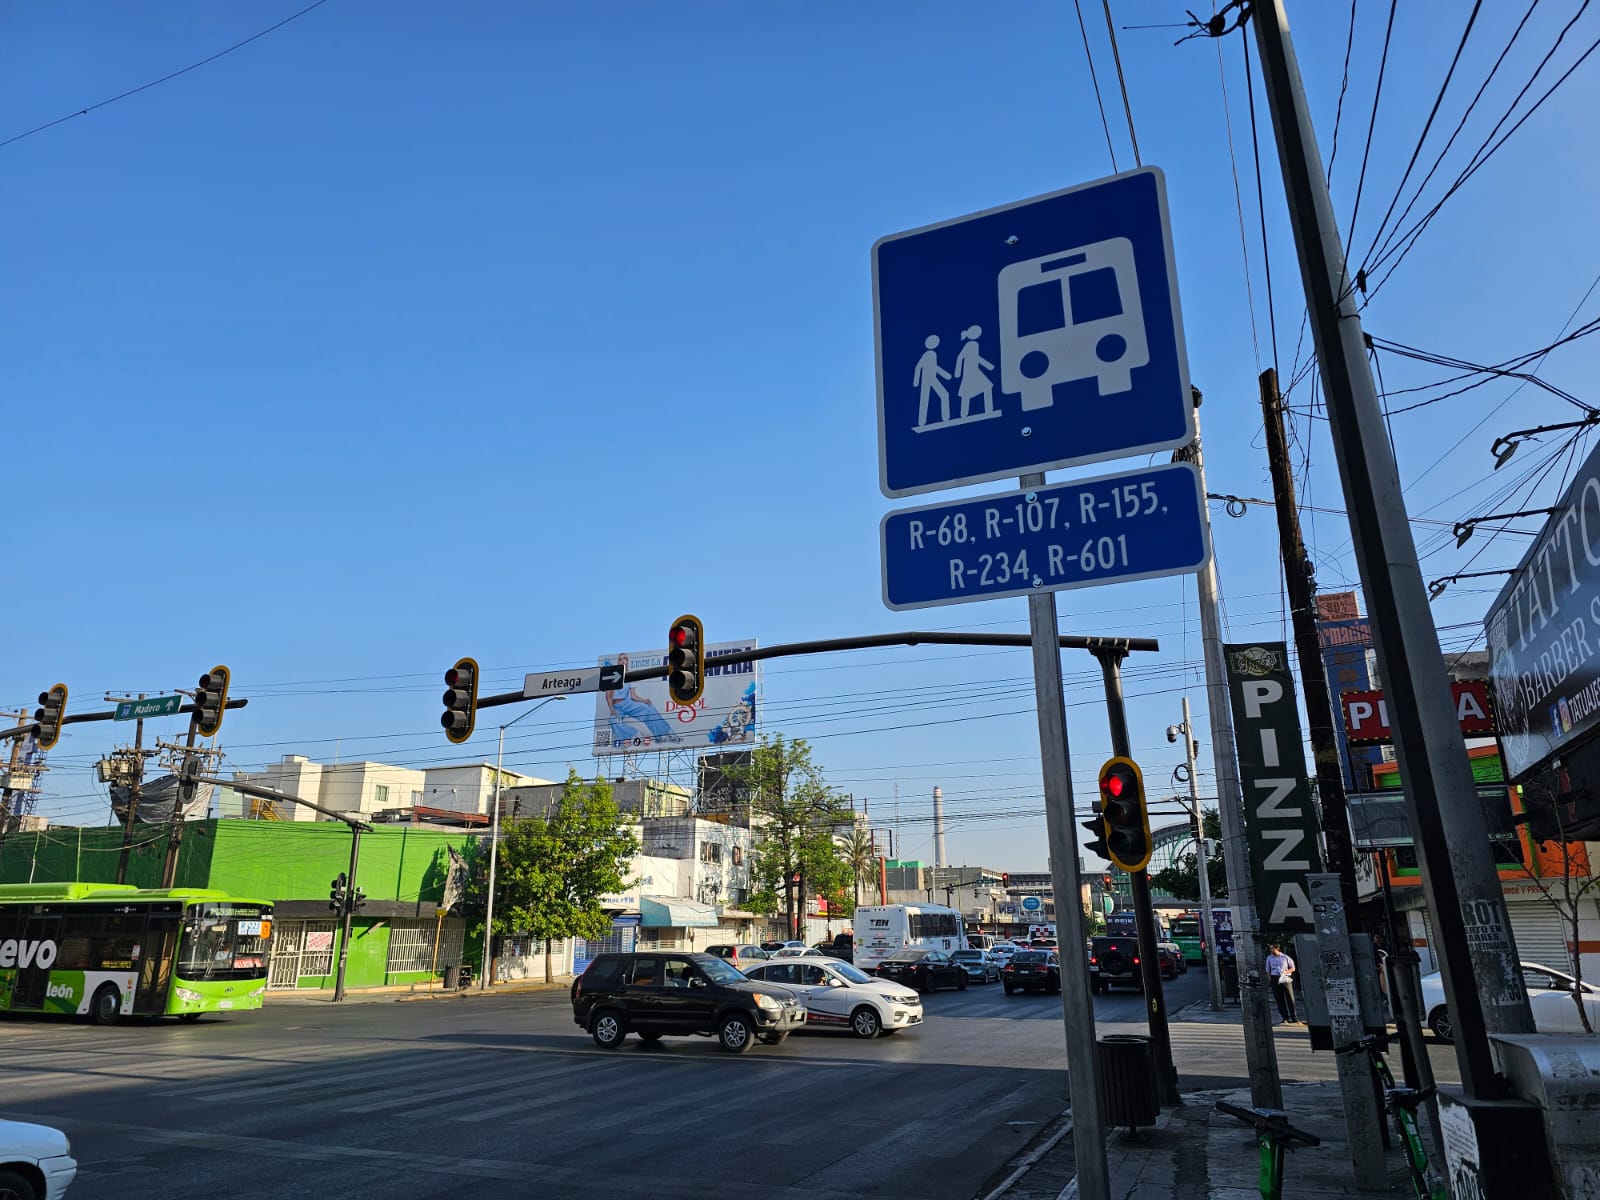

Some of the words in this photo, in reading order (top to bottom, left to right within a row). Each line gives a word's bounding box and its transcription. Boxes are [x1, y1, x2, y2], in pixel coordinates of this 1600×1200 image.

[909, 513, 976, 550] R-68,
[985, 498, 1069, 539] R-107,
[1079, 481, 1168, 524] R-155,
[1047, 534, 1129, 577] R-601
[630, 658, 651, 669] LUCE
[651, 656, 662, 667] LA
[1521, 616, 1595, 711] BARBER
[541, 677, 582, 691] Arteaga
[134, 703, 161, 715] Madero
[1348, 691, 1487, 730] PIA
[1241, 679, 1314, 924] PIZZA
[47, 981, 73, 998] león
